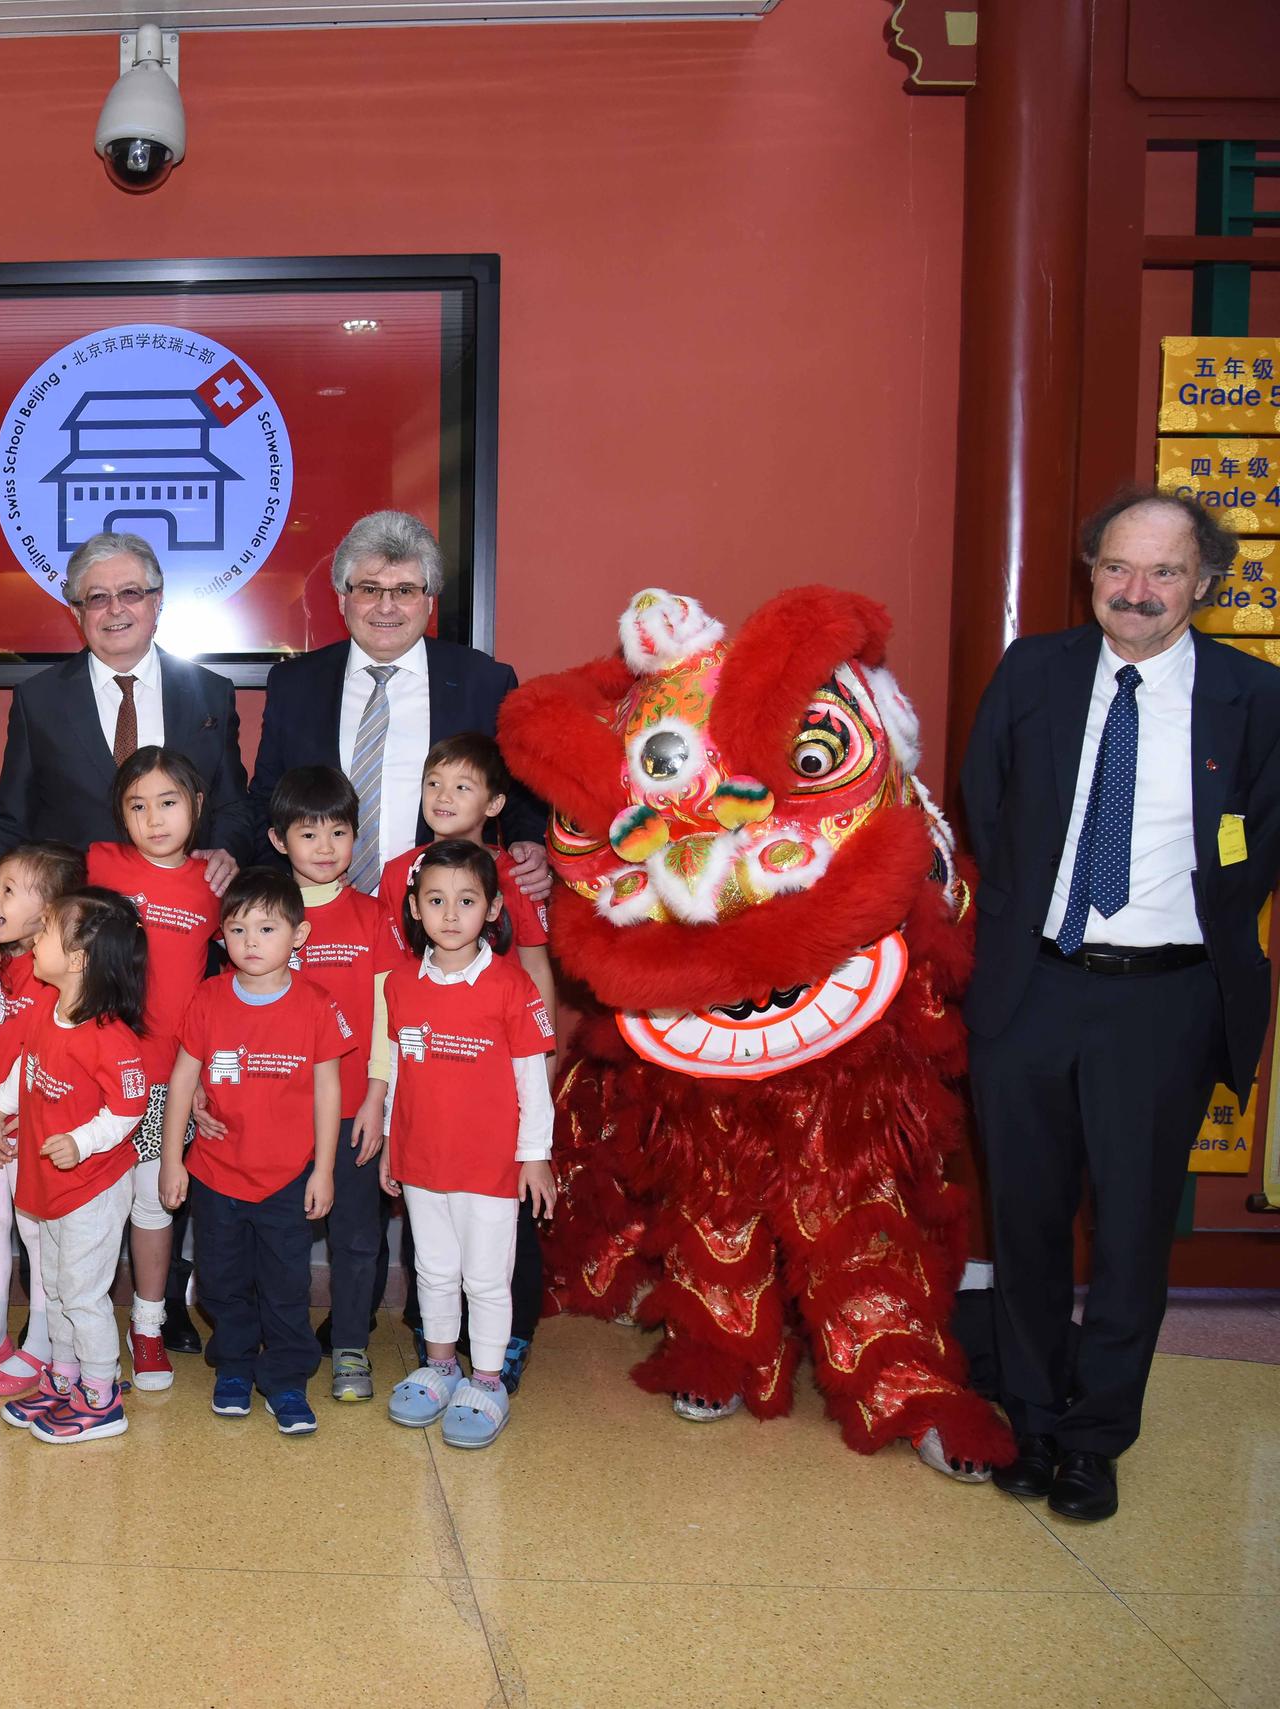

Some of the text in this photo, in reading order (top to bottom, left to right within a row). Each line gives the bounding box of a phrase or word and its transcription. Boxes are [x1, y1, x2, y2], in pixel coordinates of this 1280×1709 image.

[72, 333, 216, 365] 北京京西学校瑞士部
[1194, 357, 1274, 380] 五年级
[1179, 383, 1261, 407] Grade
[3, 372, 61, 520] Swiss School Beijing
[258, 411, 283, 492] Schweizer
[1191, 457, 1269, 479] 四年级
[1265, 485, 1280, 507] 4
[251, 497, 280, 548] Schule
[21, 535, 59, 583] Beijing
[240, 550, 256, 564] in
[1259, 587, 1277, 609] 3
[1207, 1105, 1234, 1125] 班
[1234, 1137, 1247, 1151] A
